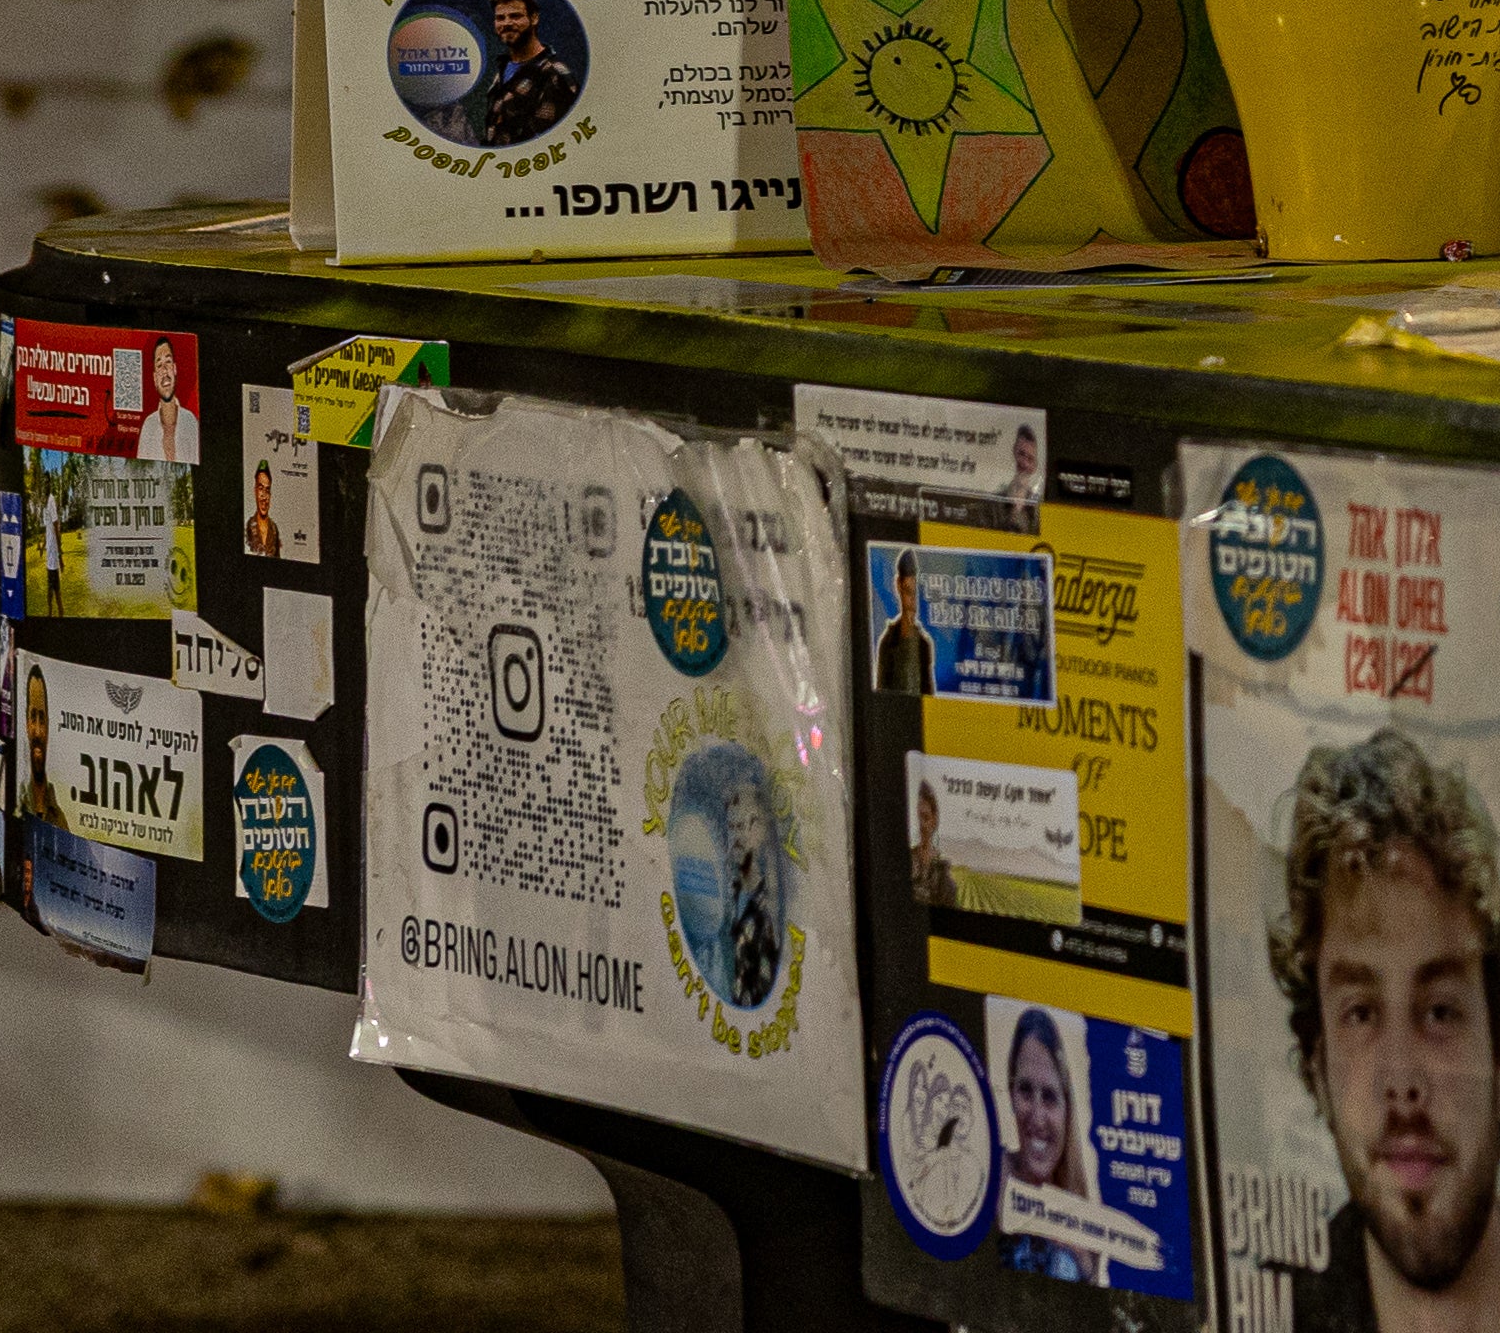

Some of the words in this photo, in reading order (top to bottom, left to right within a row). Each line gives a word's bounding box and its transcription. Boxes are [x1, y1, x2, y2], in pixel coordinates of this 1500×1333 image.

[711, 17, 777, 37] שלהם.
[434, 45, 469, 63] אלון
[662, 64, 732, 87] בכולם,
[658, 88, 734, 110] עוצמתי,
[570, 116, 598, 145] אי
[716, 111, 746, 130] בין
[382, 125, 496, 179] להפסיק
[495, 142, 567, 179] אפשר
[506, 179, 697, 218] ושתפו...
[49, 350, 66, 372] את
[66, 351, 113, 377] מחזירים
[56, 384, 91, 407] הביתה
[1216, 543, 1318, 586] חטופים
[649, 570, 721, 603] חטופים
[1030, 541, 1140, 647] adenza
[1336, 565, 1390, 627] ALON
[1395, 574, 1450, 636] OHEL
[57, 709, 85, 733] הטוב,
[86, 715, 104, 737] את
[106, 719, 144, 743] לחפש
[1017, 694, 1158, 754] MOMENTS
[146, 723, 199, 756] להקשיב,
[70, 752, 185, 822] לאהוב.
[78, 811, 100, 829] לביא
[100, 816, 130, 837] צביקה
[131, 820, 147, 839] של
[148, 825, 174, 845] לזכרו
[242, 825, 311, 851] חטופים
[1079, 810, 1128, 863] OPE
[400, 913, 646, 1015] @BRING.ALON.HOME
[711, 1000, 742, 1055] be
[1110, 1088, 1163, 1127] דורון
[1220, 1168, 1333, 1275] BRING
